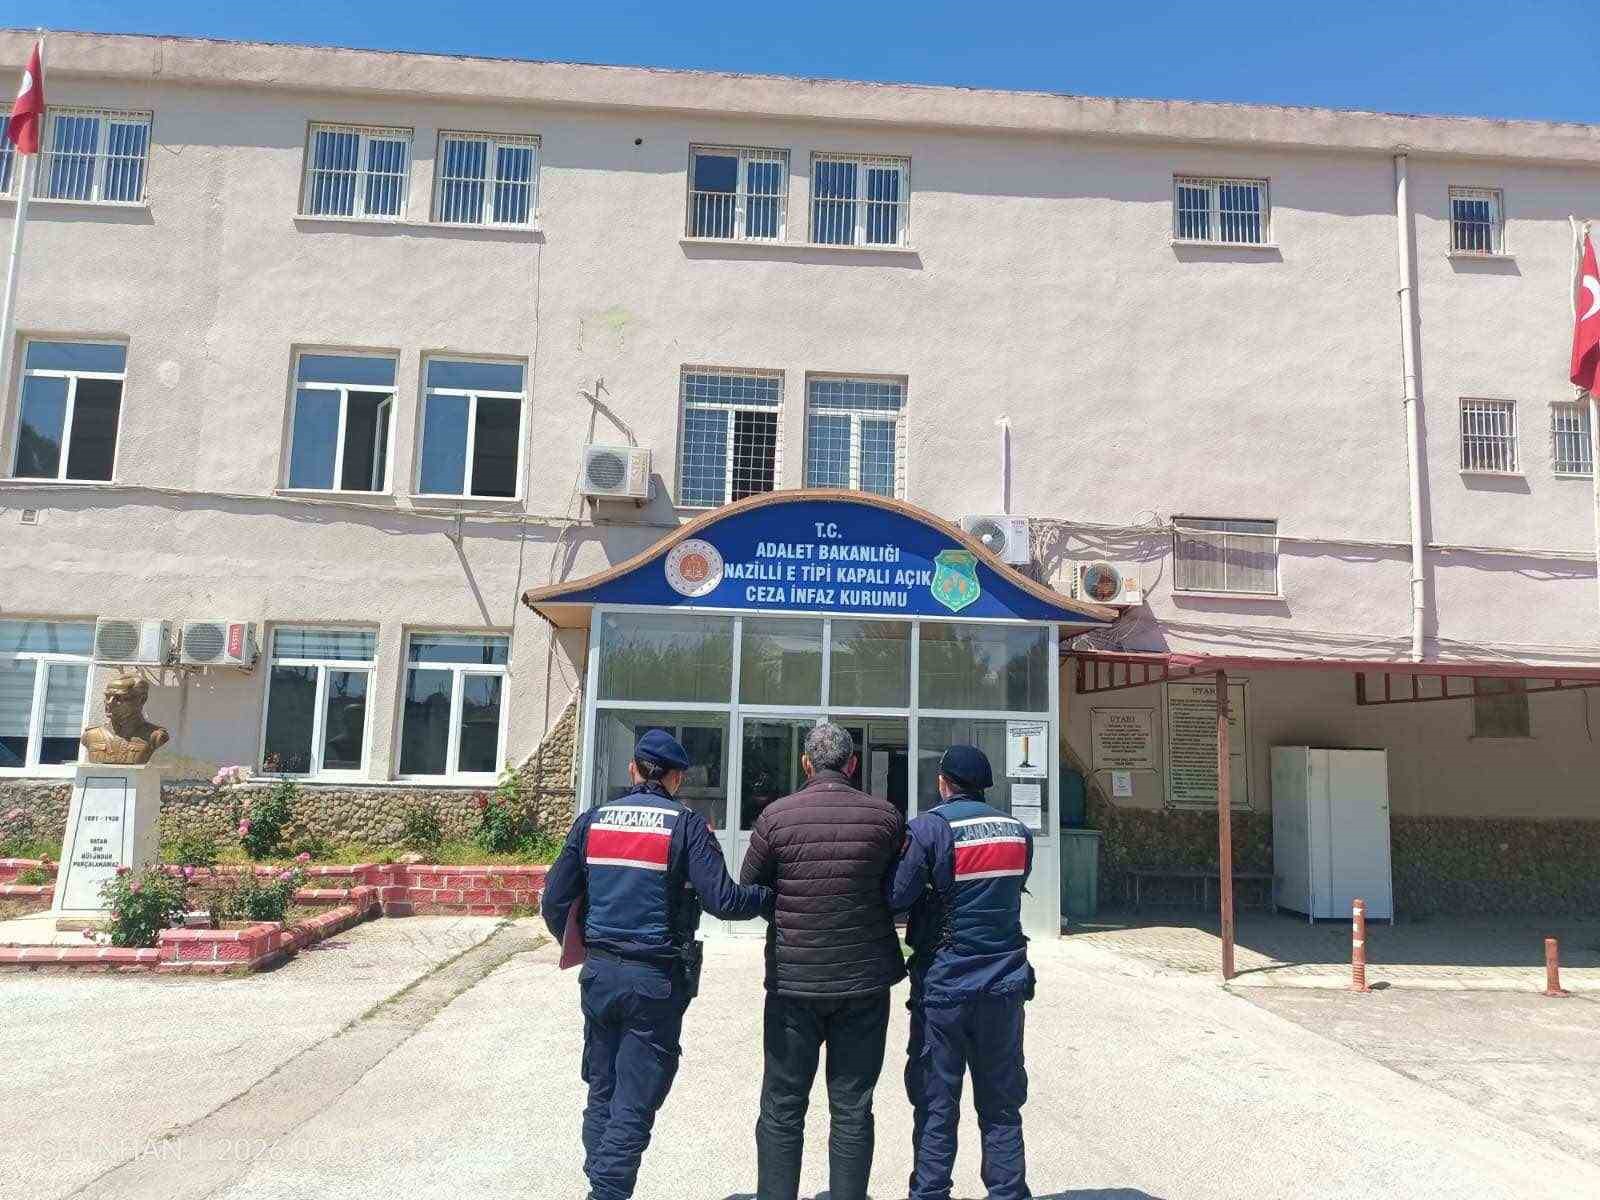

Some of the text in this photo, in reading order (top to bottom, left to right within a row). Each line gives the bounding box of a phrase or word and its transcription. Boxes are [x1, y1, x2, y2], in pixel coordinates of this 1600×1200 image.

[815, 522, 842, 538] T.C.
[756, 542, 899, 562] ADALET BAKANLIĞI
[724, 562, 931, 589] NAZİLLİ E TİPİ KAPALI AÇIK
[746, 585, 907, 607] CEZA İNFAZ KURUMU
[600, 810, 664, 829] JANDARMA
